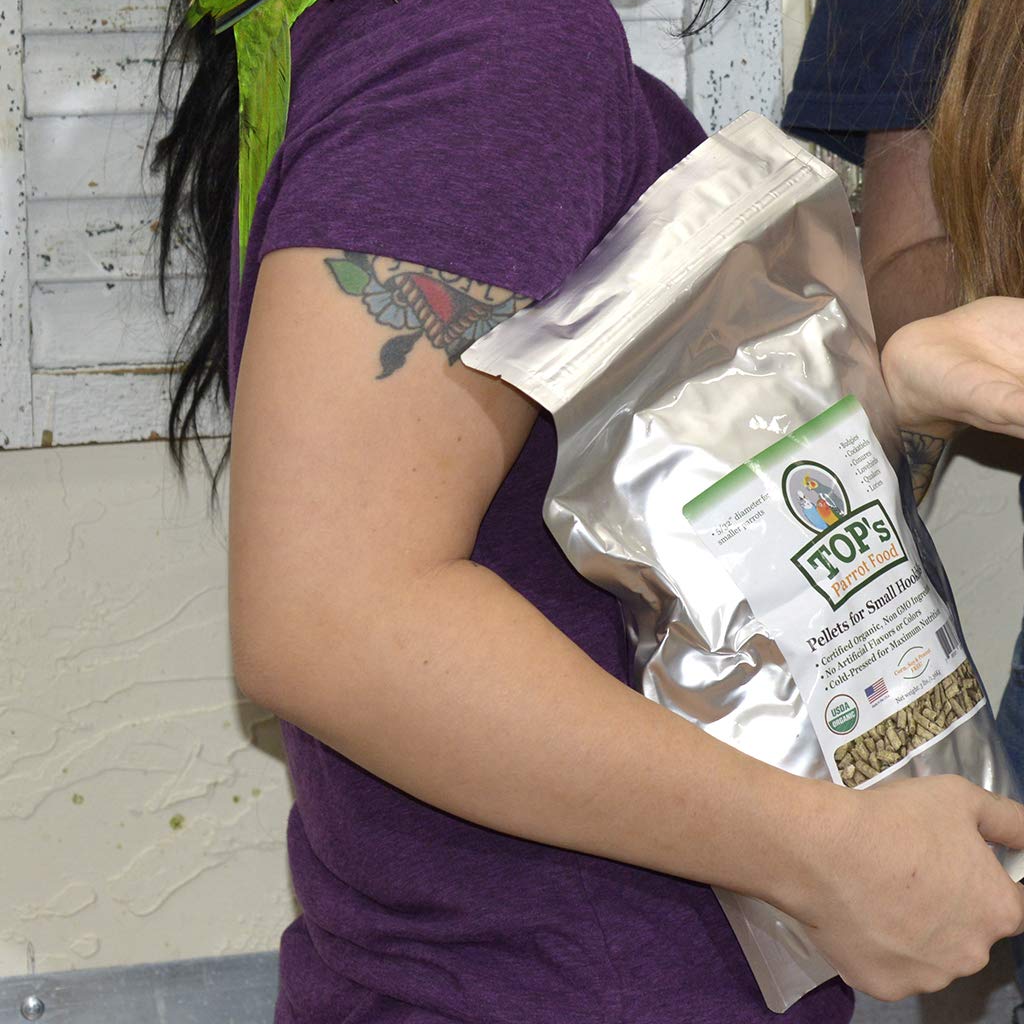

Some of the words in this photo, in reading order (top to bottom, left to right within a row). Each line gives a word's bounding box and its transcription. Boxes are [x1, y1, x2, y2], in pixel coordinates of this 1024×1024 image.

[718, 527, 741, 545] smaller
[734, 498, 762, 521] diameter
[807, 517, 891, 580] TOP's
[831, 561, 870, 597] Parrot
[868, 543, 899, 568] Food
[806, 620, 850, 653] Pellets
[849, 609, 865, 626] for
[866, 584, 897, 615] Small
[821, 639, 854, 666] Certified
[853, 622, 884, 645] Organic,
[882, 611, 898, 626] Non
[896, 600, 912, 616] GMO
[825, 667, 836, 679] No
[838, 644, 869, 673] Artificial
[869, 628, 896, 649] Flavors
[895, 623, 904, 633] or
[903, 609, 922, 626] Colors
[829, 653, 877, 690] Cold-Pressed
[877, 646, 889, 662] for
[889, 625, 922, 651] Maximum
[831, 702, 850, 717] USDA
